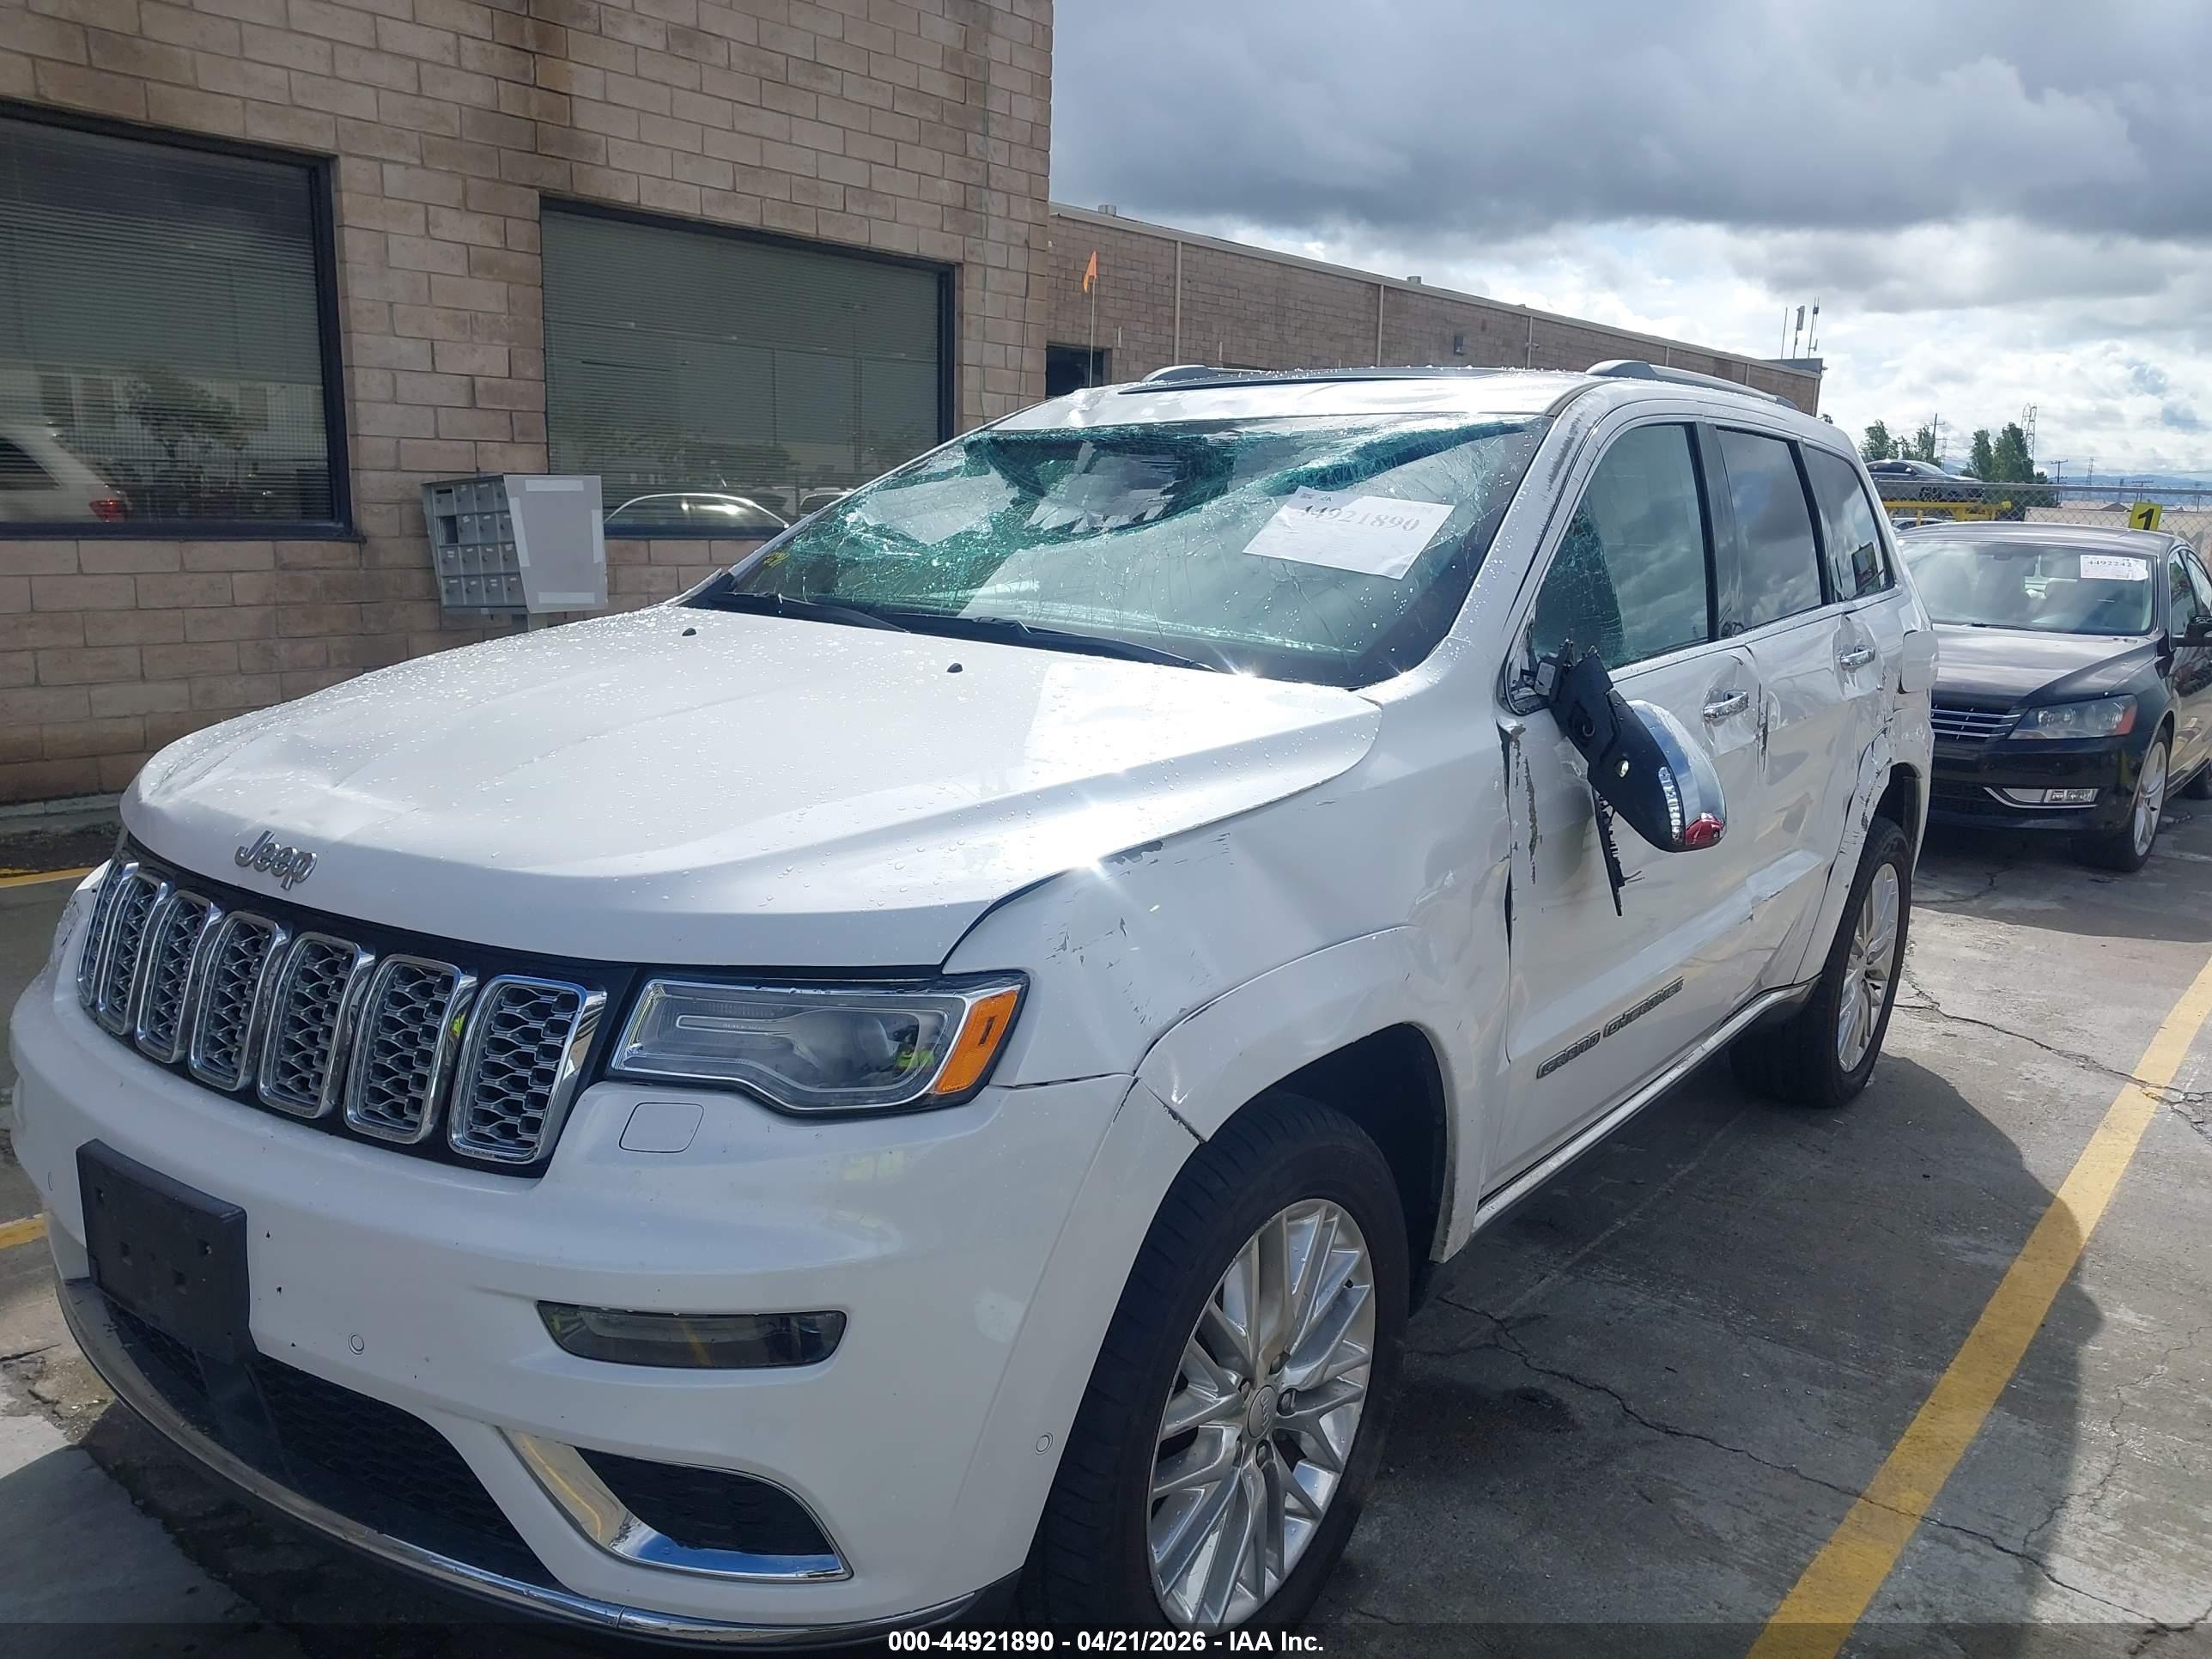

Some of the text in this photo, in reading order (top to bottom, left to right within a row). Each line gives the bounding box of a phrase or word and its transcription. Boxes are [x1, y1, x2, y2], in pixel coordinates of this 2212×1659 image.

[1298, 504, 1420, 532] 44921890
[2137, 507, 2155, 530] 1
[2087, 559, 2138, 568] 4492242
[234, 830, 318, 890] Jeep
